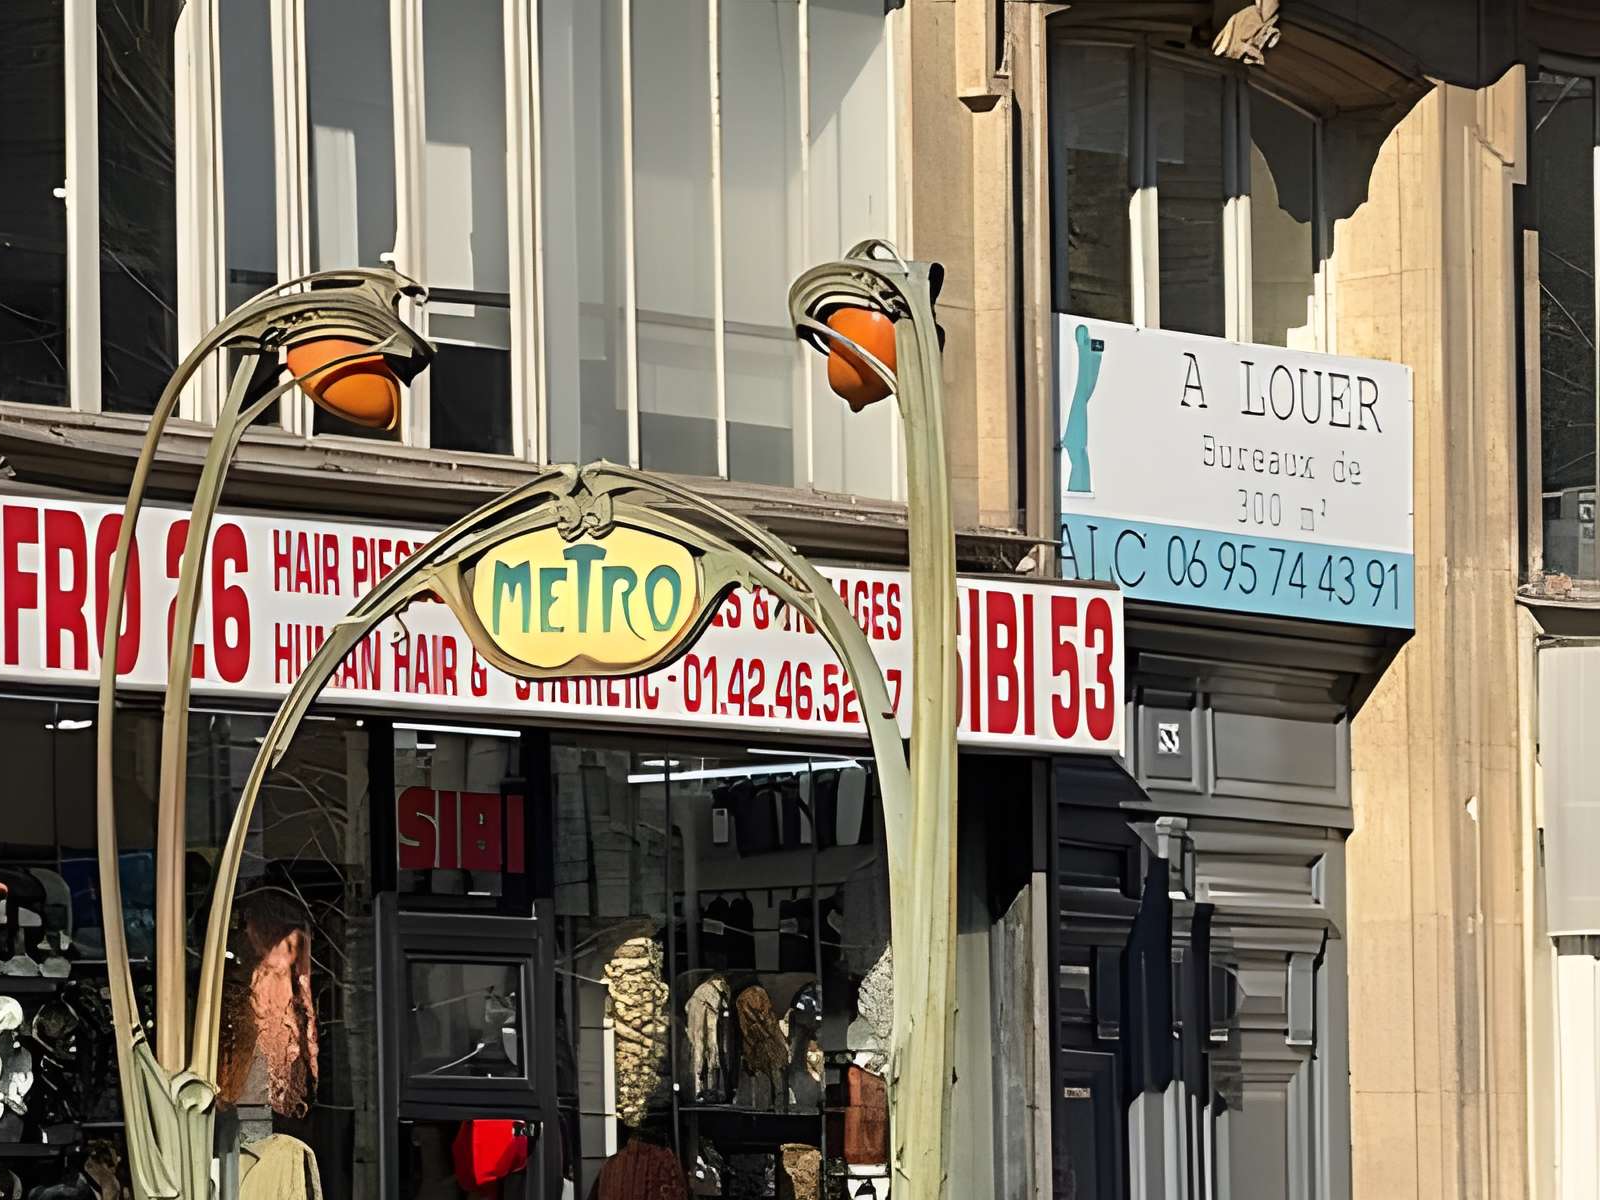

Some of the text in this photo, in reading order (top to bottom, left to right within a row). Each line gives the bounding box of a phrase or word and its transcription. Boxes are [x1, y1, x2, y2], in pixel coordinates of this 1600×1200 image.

[1181, 352, 1383, 433] A LOUER
[1203, 434, 1362, 485] Bureaux de
[1238, 489, 1281, 527] 300
[273, 529, 340, 595] HAIR
[493, 544, 682, 641] METRO
[394, 629, 458, 696] HAIR
[1051, 595, 1115, 741] 53
